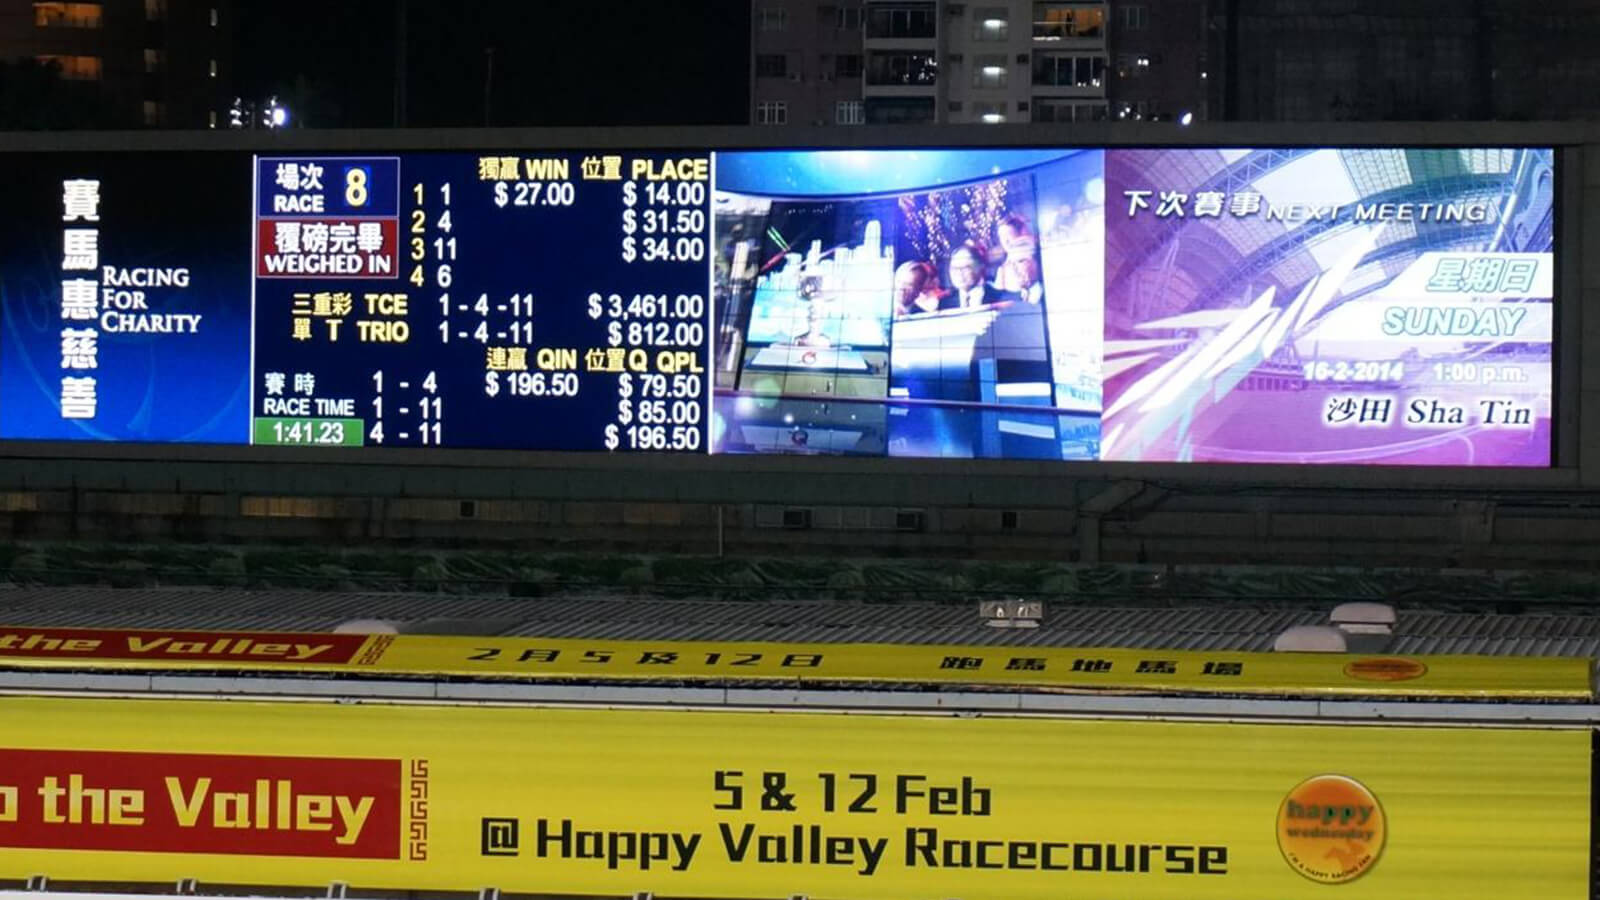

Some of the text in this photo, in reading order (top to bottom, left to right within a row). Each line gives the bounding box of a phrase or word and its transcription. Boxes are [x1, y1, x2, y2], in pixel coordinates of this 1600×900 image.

[275, 162, 324, 191] 場次
[525, 158, 570, 181] WIN
[580, 156, 622, 180] 位置
[631, 158, 709, 181] PLACE
[345, 168, 368, 207] 8
[413, 182, 424, 206] 1
[440, 182, 451, 206] 1
[274, 194, 325, 213] RACE
[1123, 190, 1487, 222] 下次賽事 NEXT MEETING
[411, 209, 426, 233] 2
[437, 209, 452, 233] 4
[274, 221, 384, 254] 覆磅完畢
[410, 237, 425, 261] 3
[433, 237, 457, 261] 11
[102, 266, 190, 287] RACING
[264, 254, 392, 274] WEIGHED IN
[410, 264, 452, 288] 4 6
[1425, 257, 1539, 294] 星期日
[60, 178, 101, 419] 賽馬惠慈善
[102, 289, 148, 310] FOR
[291, 291, 409, 316] 三重彩 TCE
[101, 312, 202, 333] CHARITY
[356, 320, 409, 343] TRIO
[1382, 306, 1528, 337] SUNDAY
[486, 346, 528, 371] 連贏
[537, 347, 577, 371] QIN
[656, 350, 705, 374] QPL
[1303, 361, 1529, 385] 16-2-2014 1:00 p.m.
[263, 397, 355, 417] RACE TIME
[1326, 397, 1532, 426] 沙田 Sha Tin
[272, 421, 345, 444] 1:41.23
[0, 634, 335, 660] the Valley
[714, 771, 992, 817] 5 & 12 Feb
[37, 773, 145, 826] the
[164, 775, 375, 846] Valley
[1286, 798, 1375, 826] happy
[481, 817, 1229, 876] @ Happy Valley Racecourse
